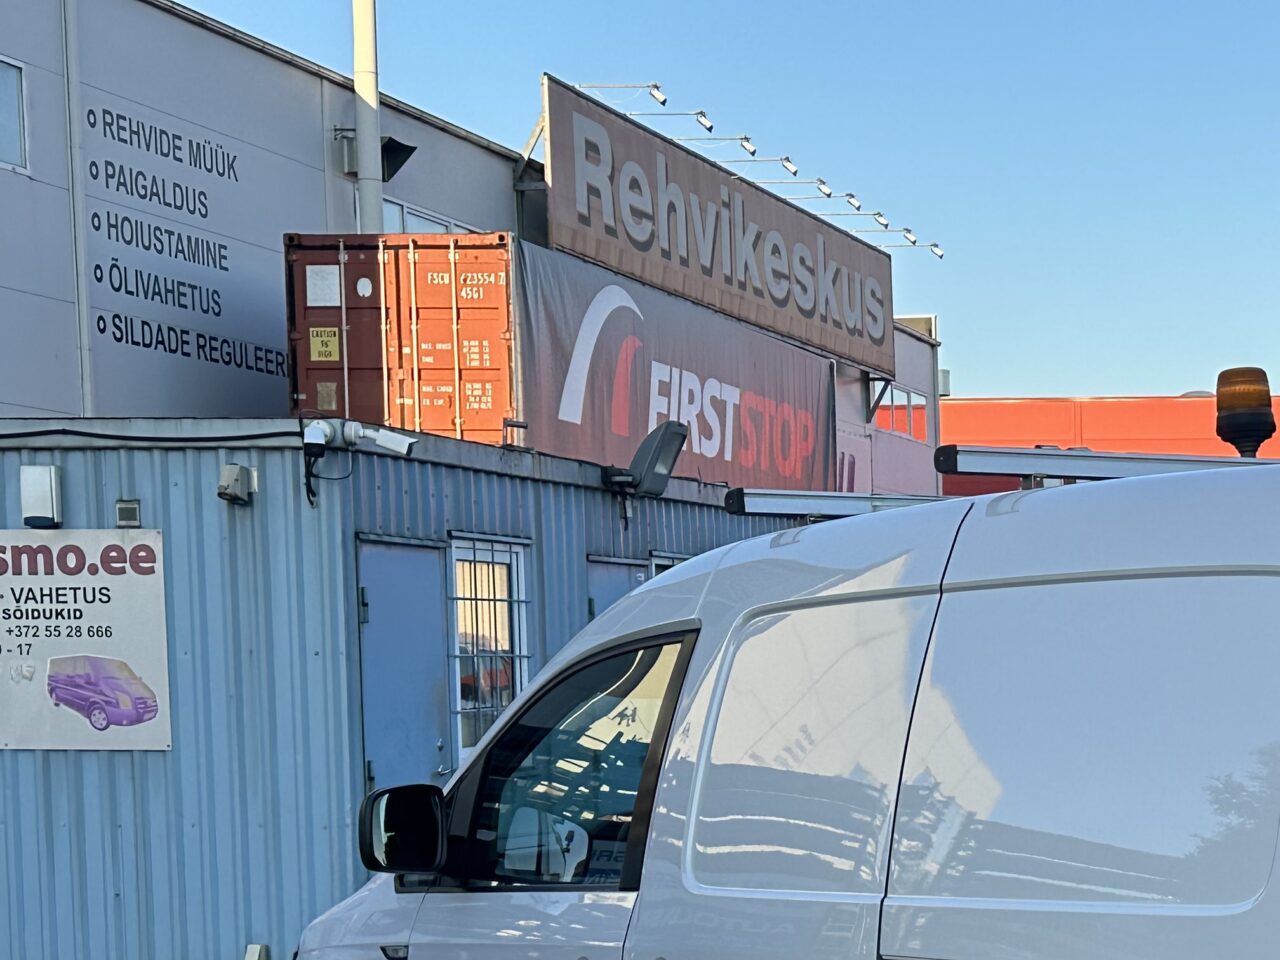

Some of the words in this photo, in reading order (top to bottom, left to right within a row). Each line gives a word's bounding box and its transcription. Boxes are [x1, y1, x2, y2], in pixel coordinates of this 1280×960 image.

[102, 108, 183, 163] REHVIDE
[188, 138, 239, 182] MÜÜK
[104, 160, 208, 219] PAIGALDUS
[106, 211, 229, 272] HOIUSTAMINE
[572, 111, 886, 347] Rehvikeskus
[108, 257, 222, 317] ÕLIVAHETUS
[112, 313, 191, 358] SILDADE
[2, 605, 84, 620] SÕIDUKID
[10, 586, 112, 604] VAHETUS
[6, 625, 40, 638] +372
[44, 625, 62, 638] 55
[65, 625, 83, 638] 28
[87, 625, 113, 638] 666
[17, 643, 32, 656] 17
